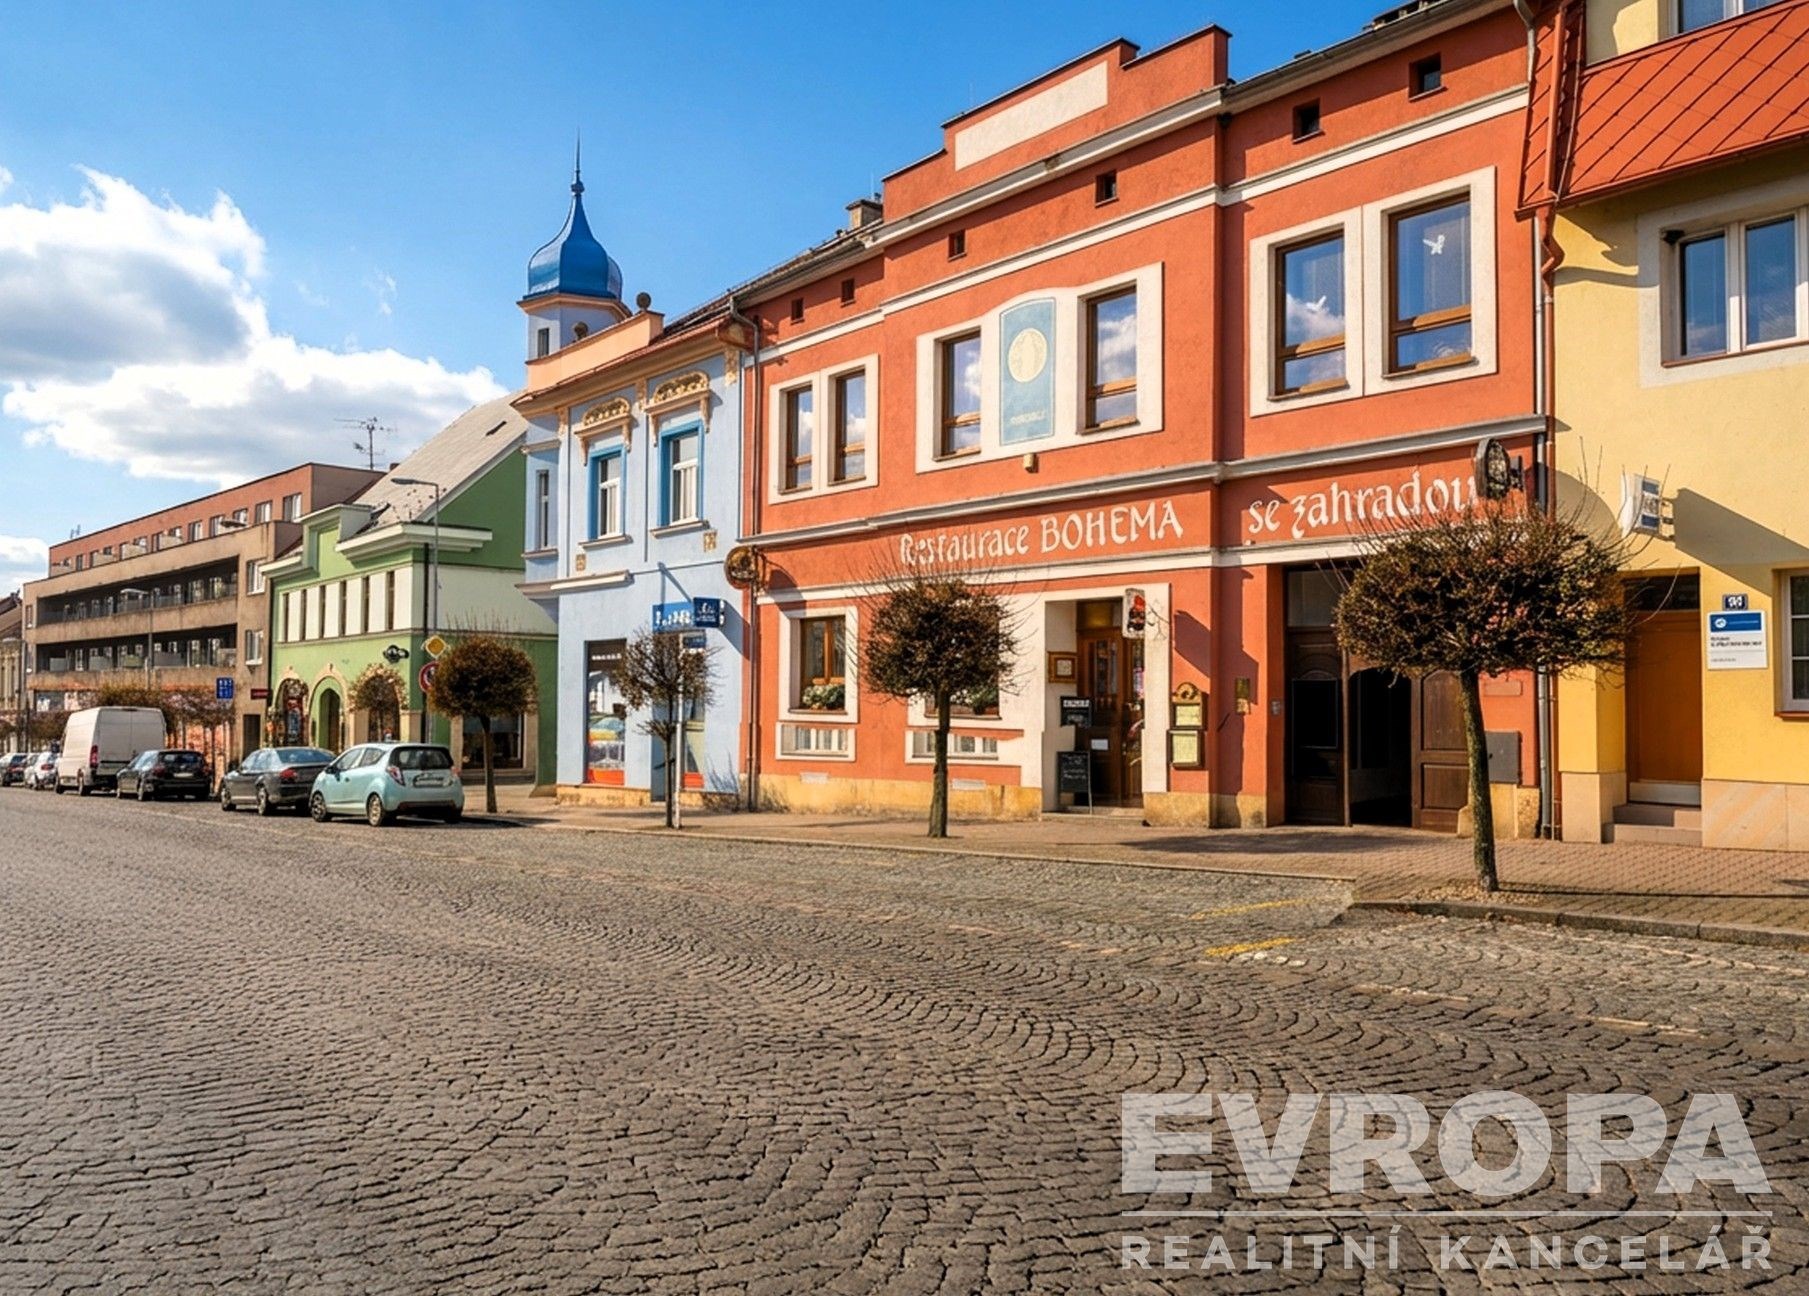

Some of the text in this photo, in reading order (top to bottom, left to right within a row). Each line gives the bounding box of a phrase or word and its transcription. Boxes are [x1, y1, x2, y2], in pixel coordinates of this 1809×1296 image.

[900, 500, 1184, 566] Restaurace BOHEMA
[1249, 499, 1281, 533] se
